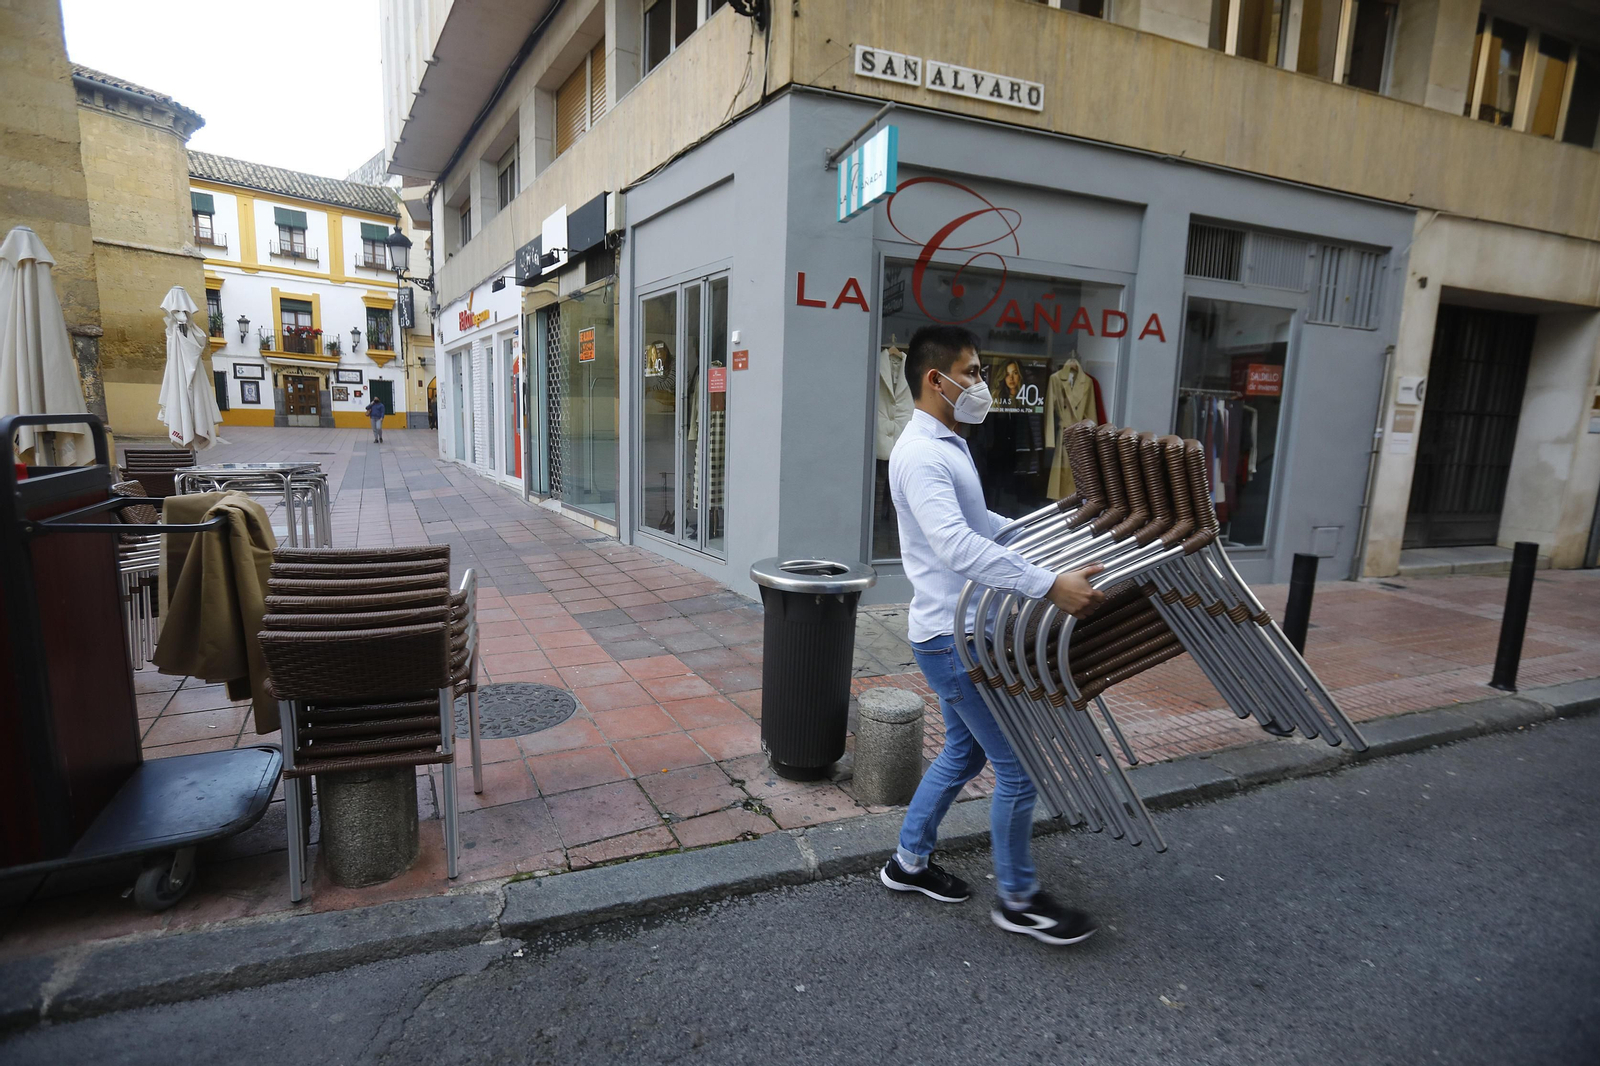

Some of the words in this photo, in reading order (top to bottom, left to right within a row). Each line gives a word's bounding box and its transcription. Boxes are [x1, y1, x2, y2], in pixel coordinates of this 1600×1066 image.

[861, 51, 918, 81] SAN
[931, 67, 1041, 106] ALVARO
[796, 271, 870, 313] LA
[887, 176, 1166, 343] CAÑADA
[1016, 384, 1044, 406] 40%
[1250, 371, 1279, 382] SALDILLO
